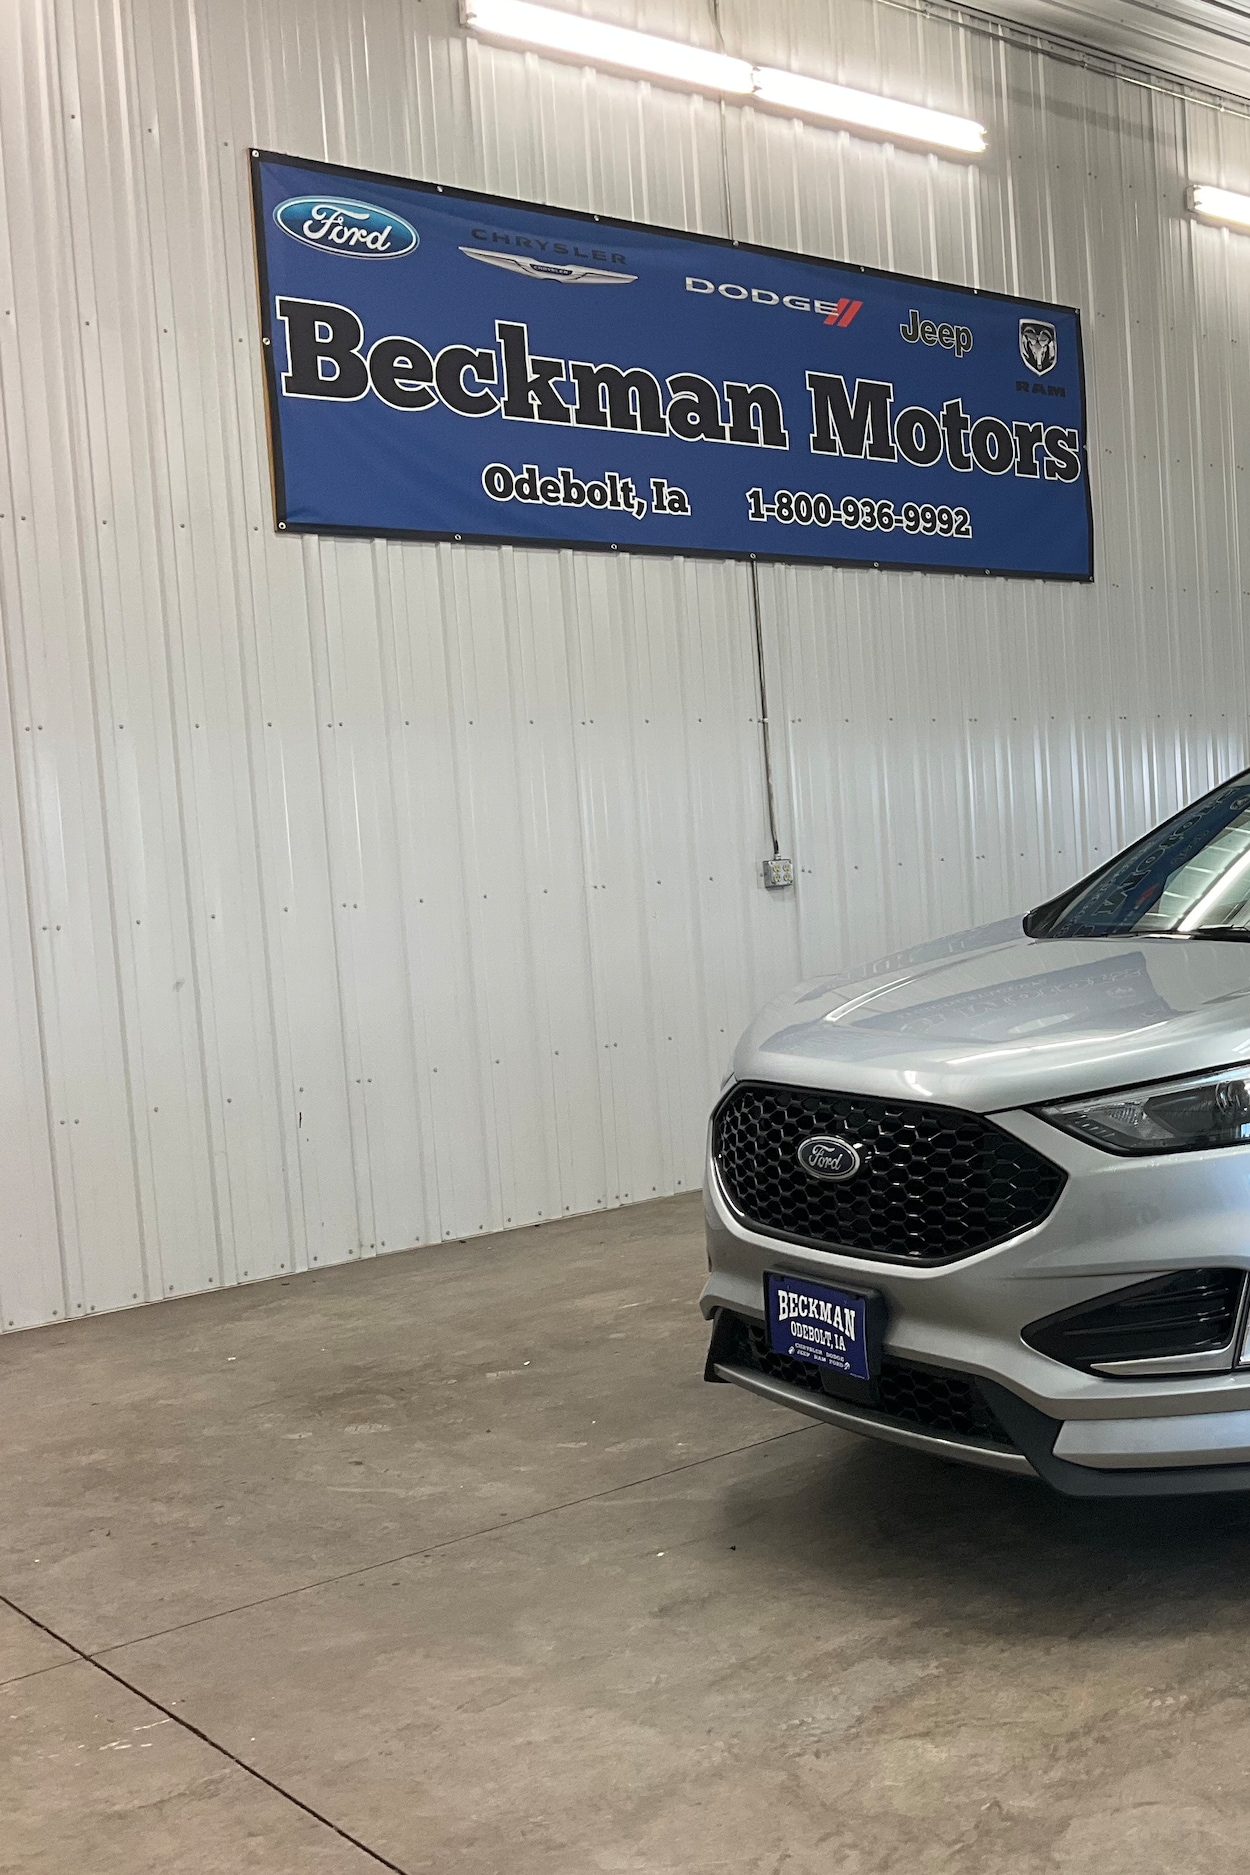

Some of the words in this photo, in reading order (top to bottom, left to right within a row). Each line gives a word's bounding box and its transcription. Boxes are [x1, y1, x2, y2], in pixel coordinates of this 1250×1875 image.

[303, 204, 393, 251] Ford
[470, 228, 627, 265] CHRYSLER
[685, 276, 839, 316] DODGE
[900, 309, 973, 357] Jeep
[276, 296, 789, 450] Beckman
[805, 371, 1081, 483] Motors
[1015, 380, 1066, 398] RAM
[482, 462, 647, 519] Odebolt,
[650, 478, 691, 516] Ia
[746, 487, 972, 538] 1-800-936-9992
[808, 1144, 843, 1171] Ford
[778, 1289, 856, 1341] BECKMAN
[790, 1320, 834, 1350] ODEBOLT,
[834, 1333, 847, 1352] IA
